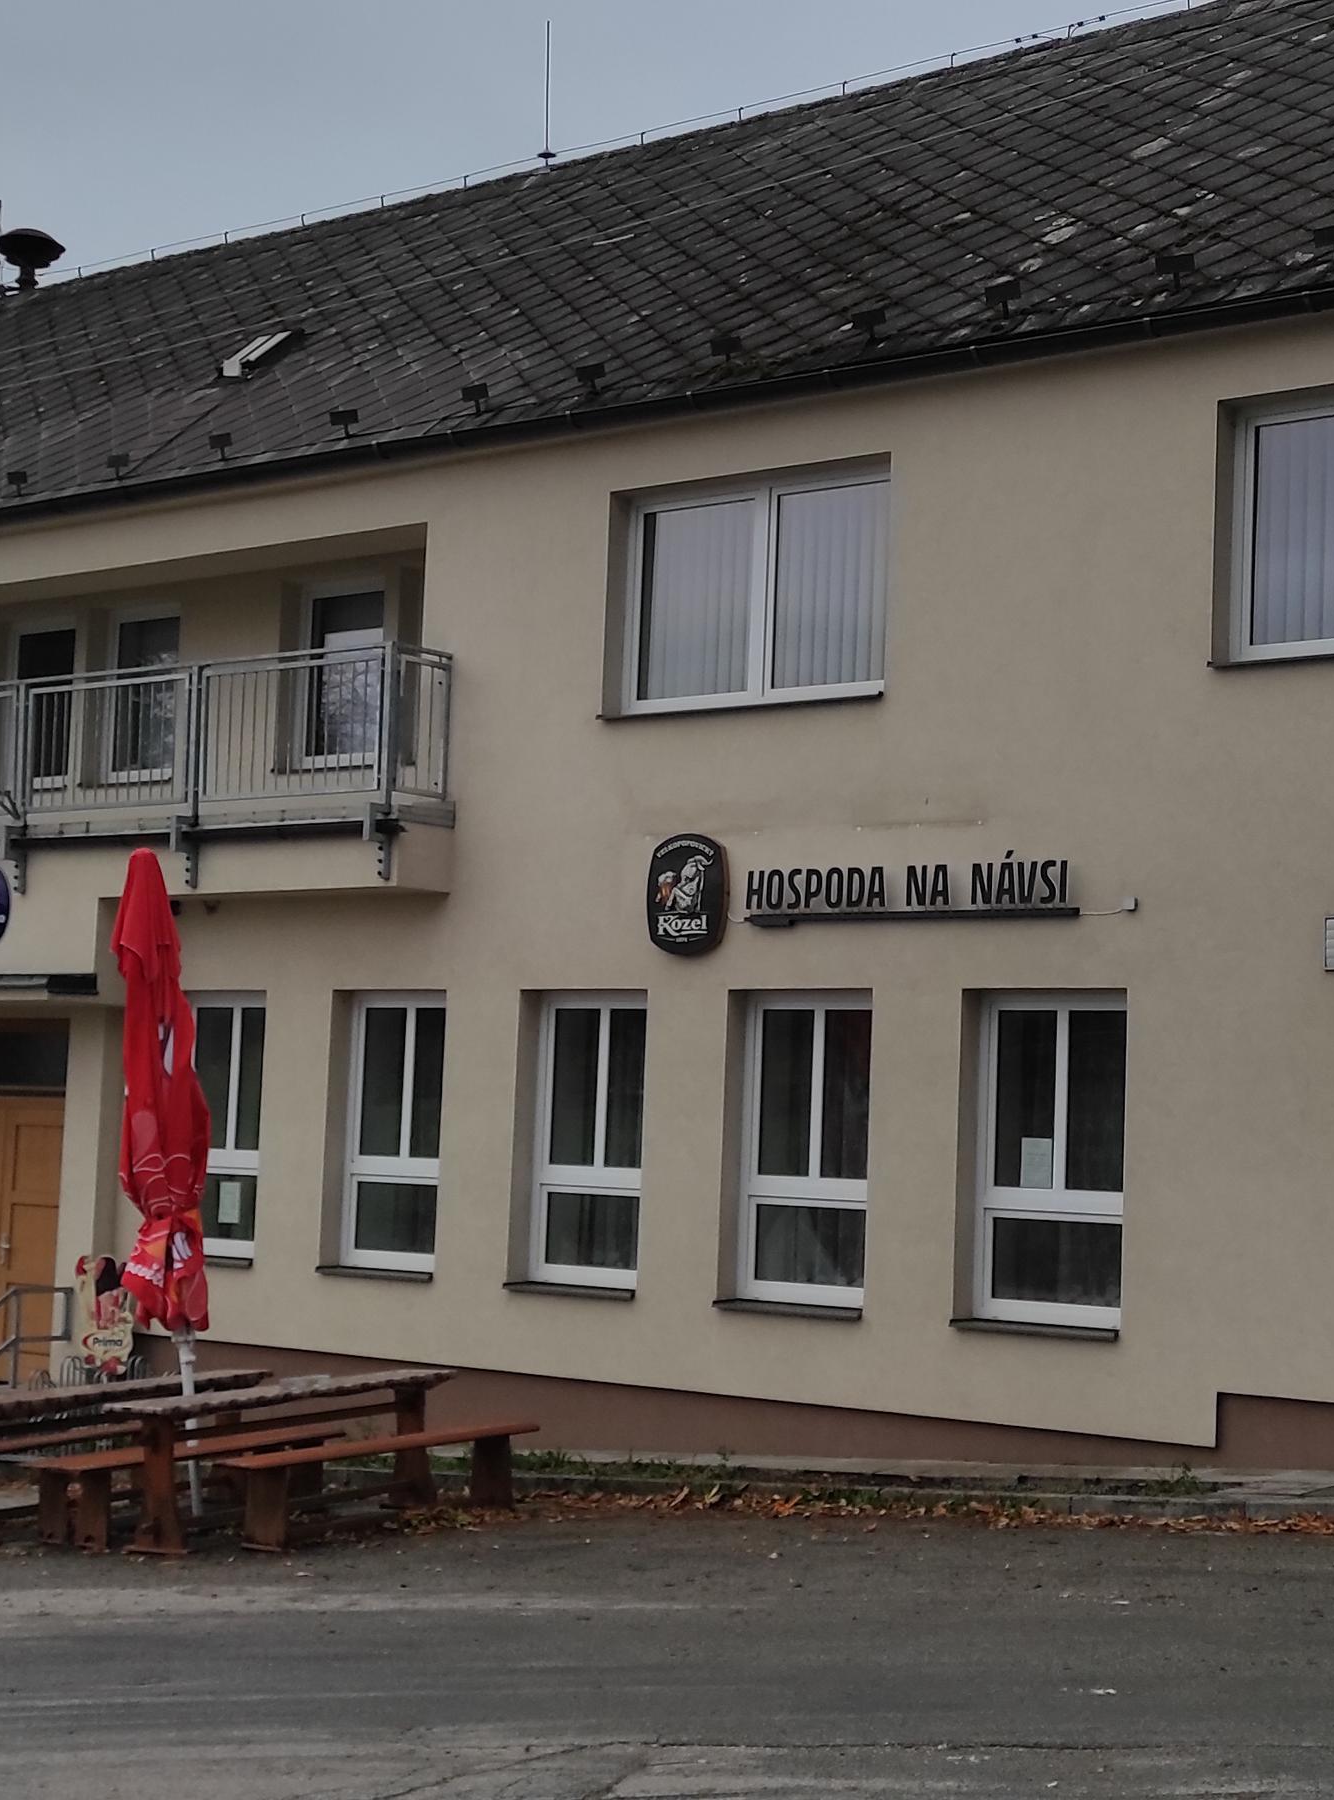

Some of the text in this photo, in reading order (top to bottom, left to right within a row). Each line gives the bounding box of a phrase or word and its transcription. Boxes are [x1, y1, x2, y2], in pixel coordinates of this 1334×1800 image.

[746, 850, 1068, 910] HOSPODA NA NÁVSI
[657, 915, 708, 937] Kozel
[92, 1337, 123, 1347] Prima
